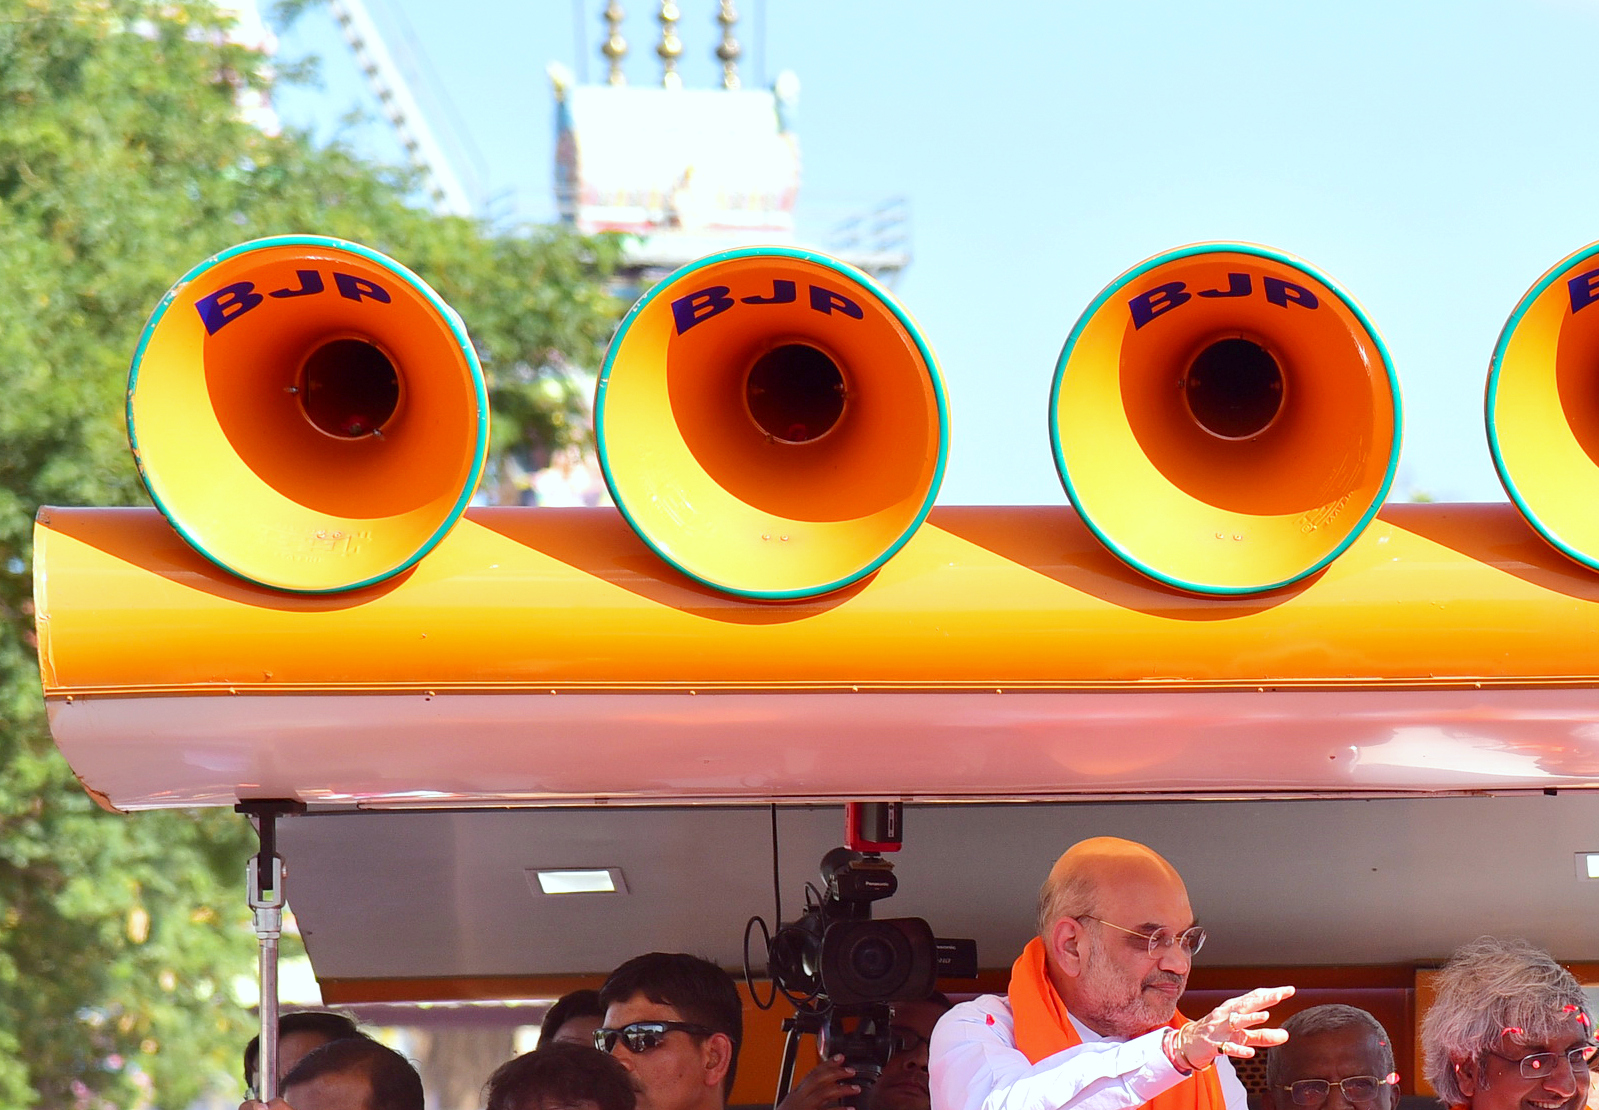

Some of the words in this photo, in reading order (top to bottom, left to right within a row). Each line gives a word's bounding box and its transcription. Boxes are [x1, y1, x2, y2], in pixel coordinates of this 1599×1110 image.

[194, 270, 391, 336] BJP
[671, 279, 864, 336] BJP
[1128, 272, 1319, 331] BJP
